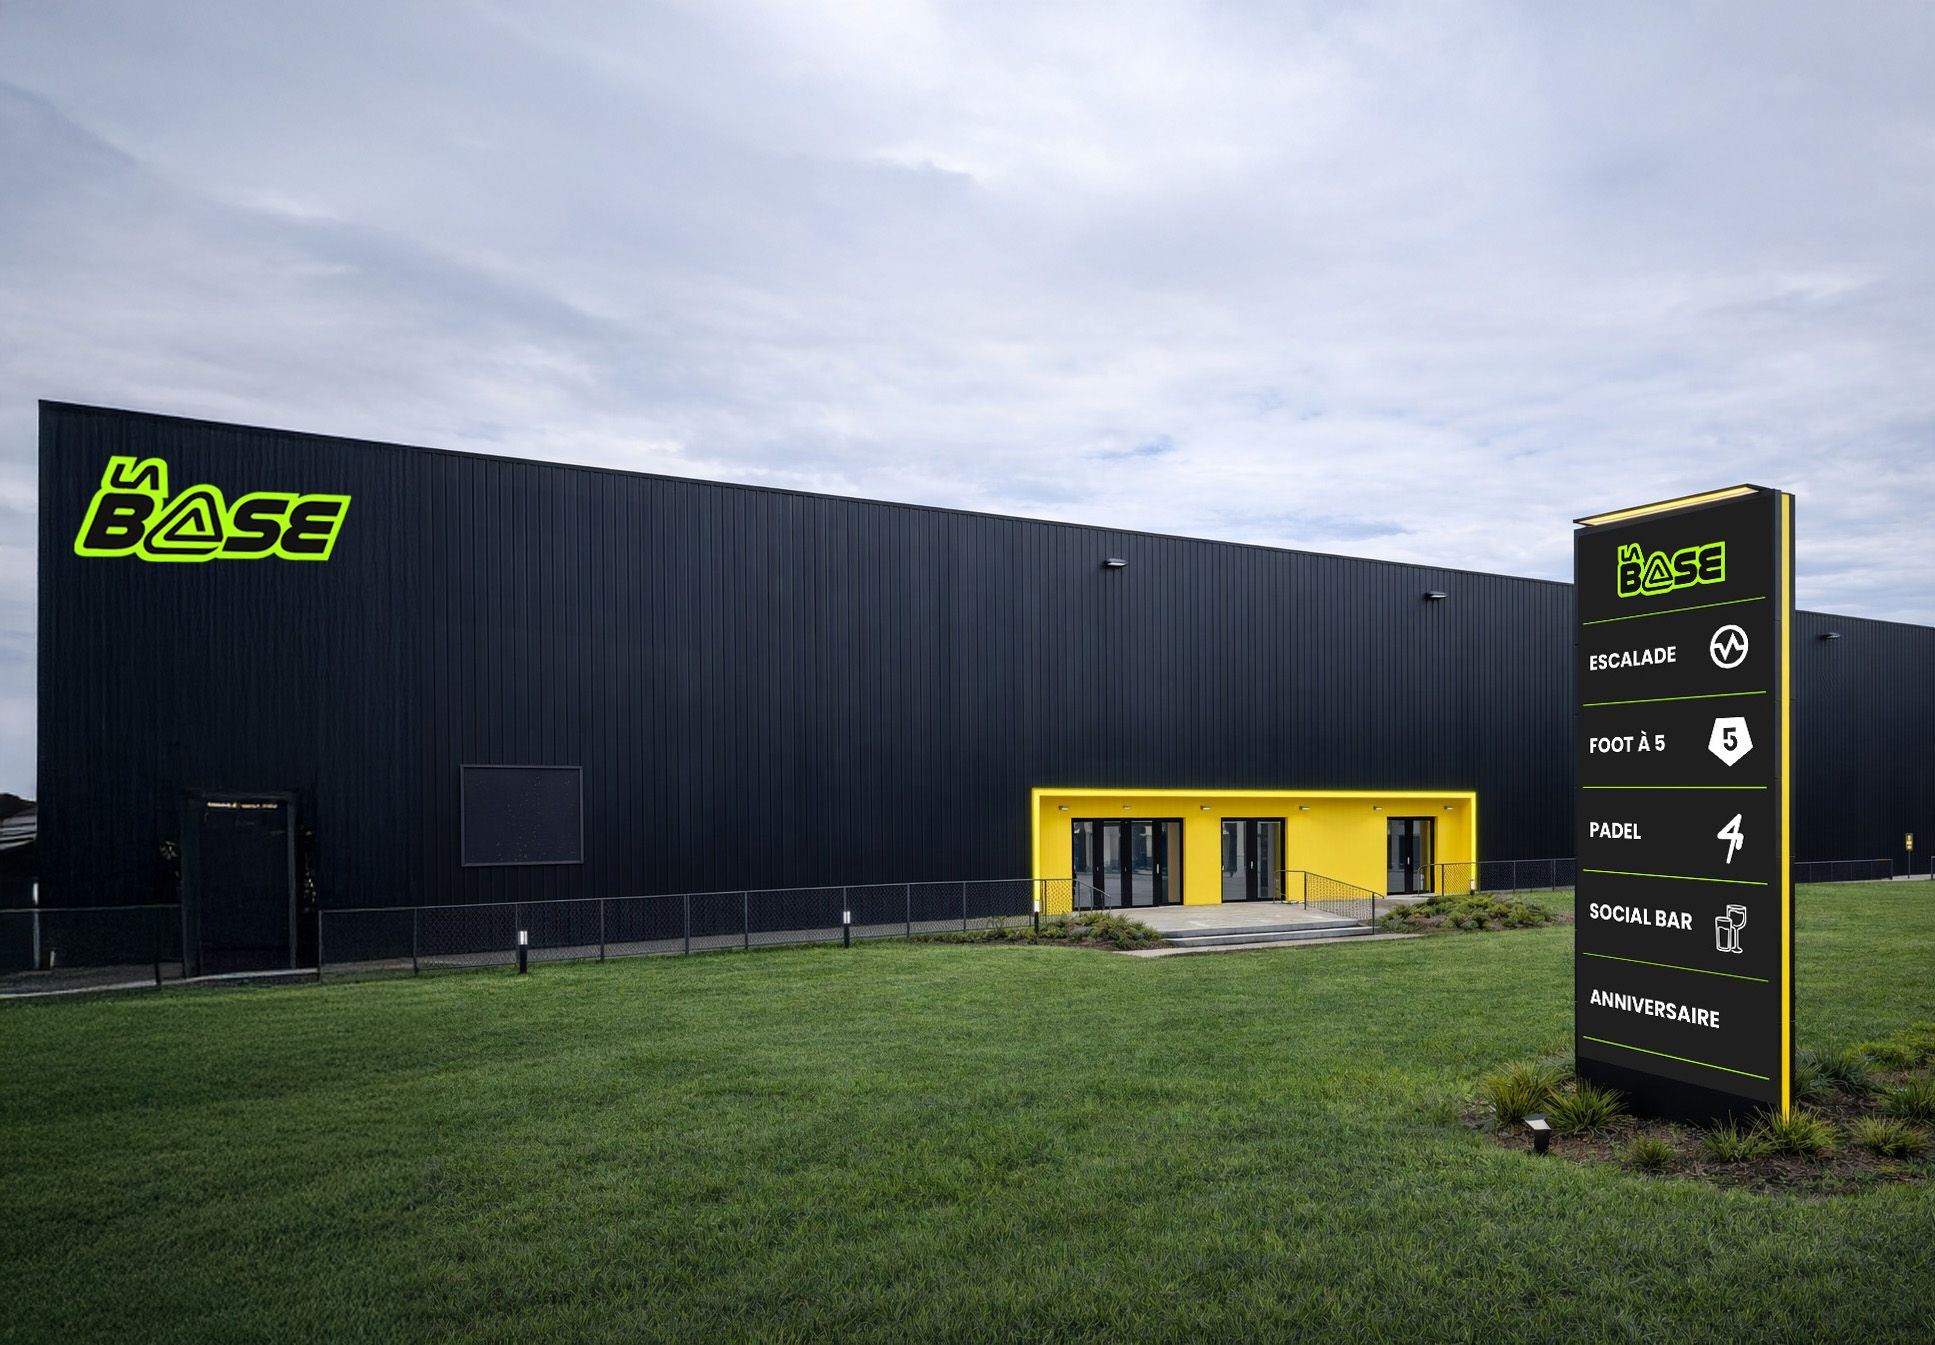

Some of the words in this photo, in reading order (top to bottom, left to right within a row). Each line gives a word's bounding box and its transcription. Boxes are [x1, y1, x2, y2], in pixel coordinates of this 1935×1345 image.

[105, 459, 164, 491] LA
[79, 487, 347, 558] BASE
[1619, 545, 1642, 562] LA
[1619, 544, 1724, 596] BASE
[1589, 646, 1677, 671] ESCALADE
[1589, 736, 1634, 753] FOOT
[1638, 730, 1650, 752] À
[1654, 734, 1666, 752] 5
[1723, 727, 1738, 751] 5
[1589, 822, 1641, 840] PADEL
[1589, 903, 1651, 926] SOCIAL
[1655, 909, 1693, 931] BAR
[1589, 989, 1720, 1029] ANNIVERSAIRE
